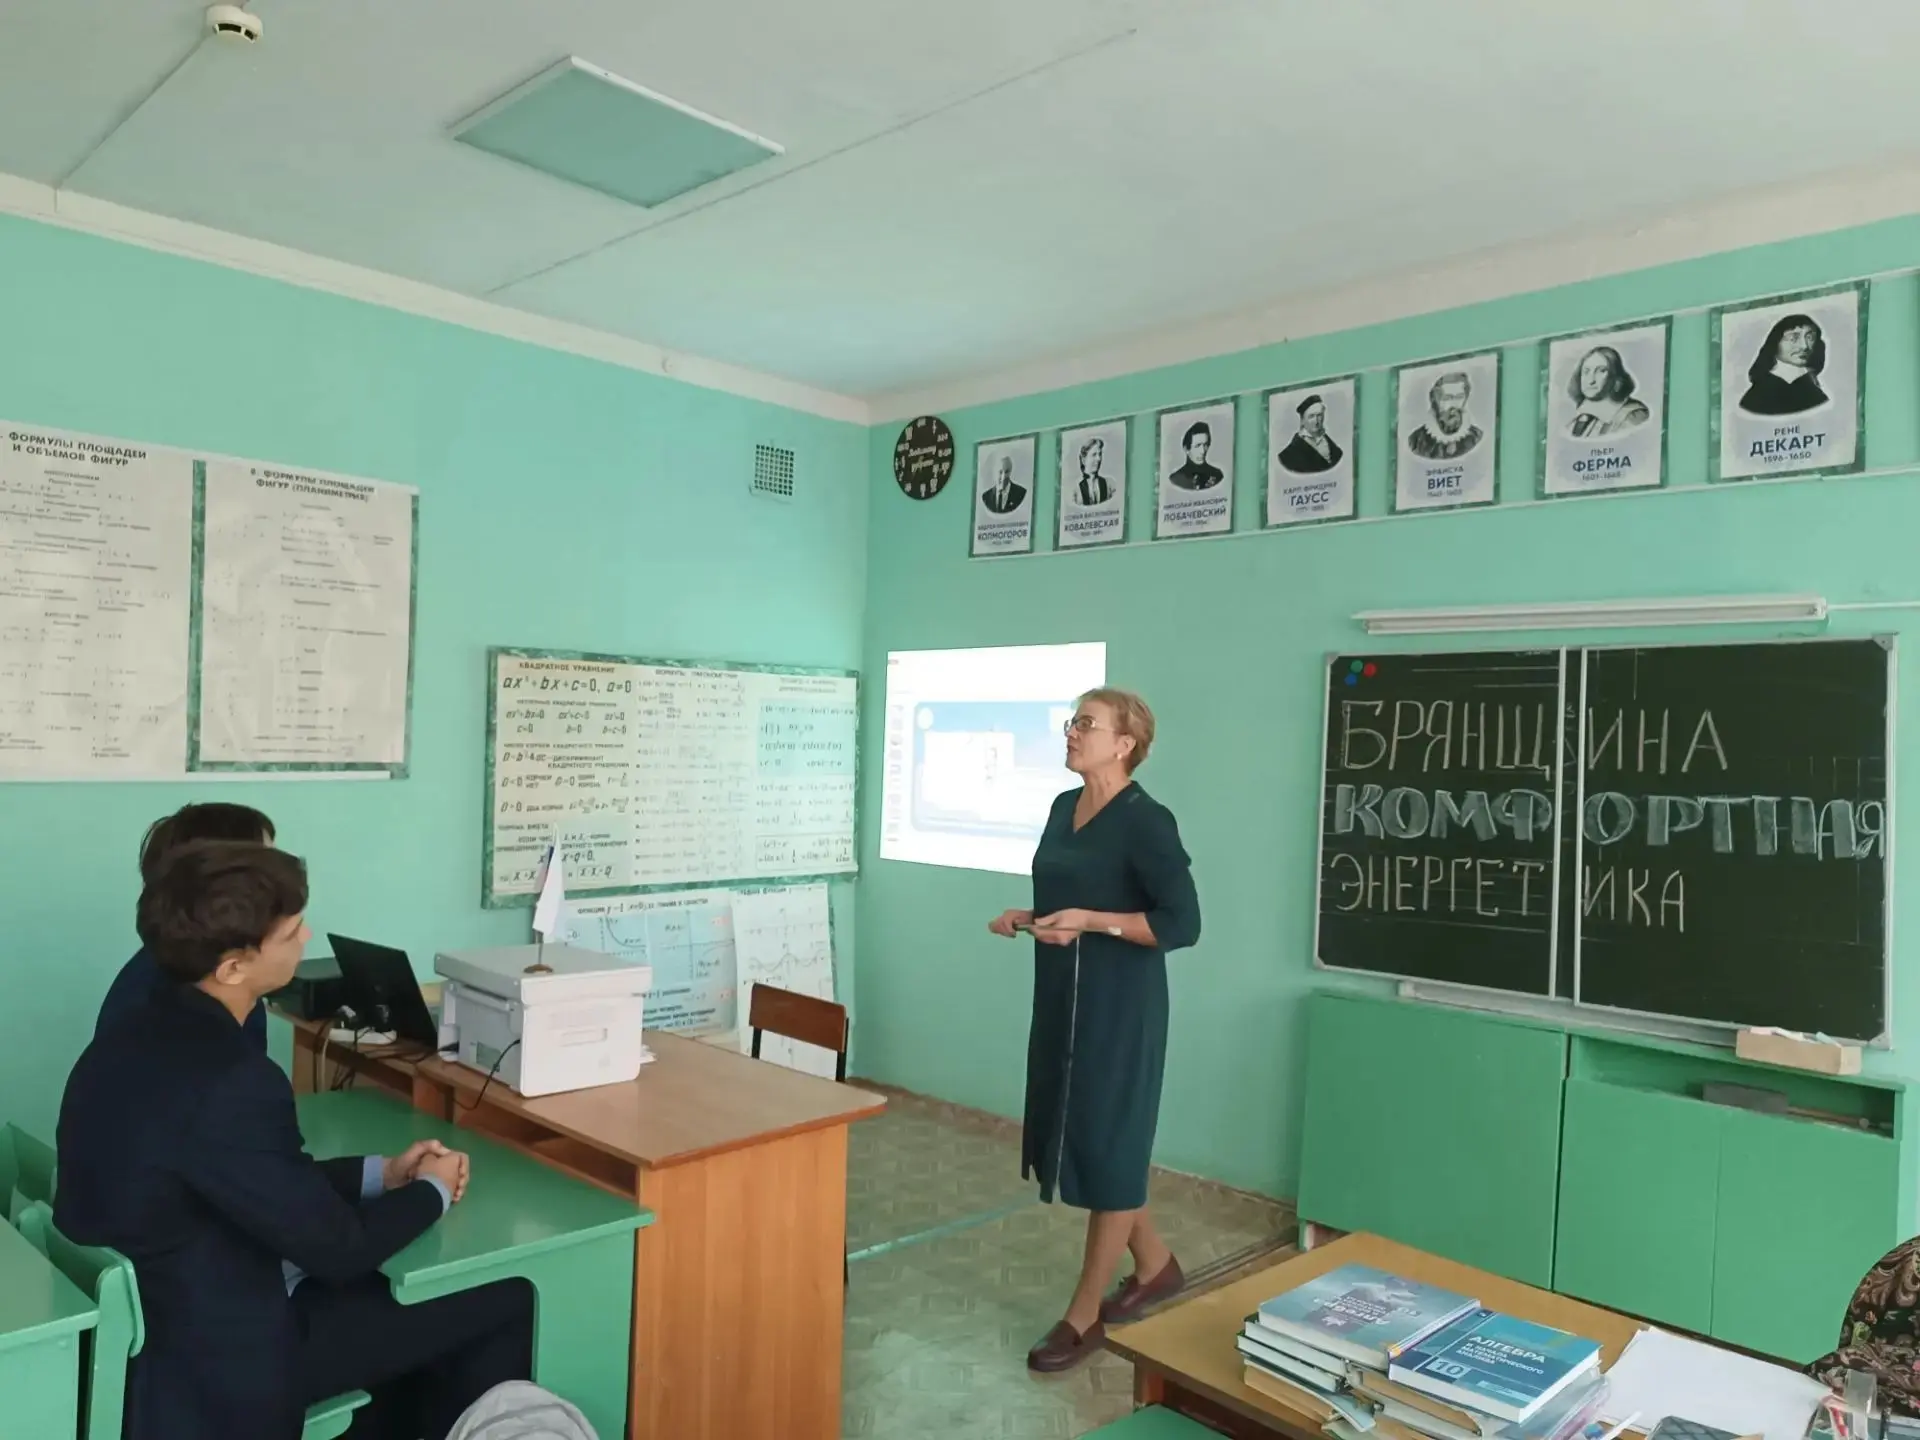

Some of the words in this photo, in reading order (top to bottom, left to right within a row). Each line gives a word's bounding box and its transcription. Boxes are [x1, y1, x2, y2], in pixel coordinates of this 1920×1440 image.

[1774, 424, 1801, 436] РЕНЕ
[9, 431, 73, 448] ФОРМУЛЫ
[1750, 433, 1826, 457] ДЕКАРТ
[13, 443, 21, 452] И
[26, 445, 86, 461] ОБЪЕМОВ
[90, 454, 129, 467] ФИГУР
[1573, 456, 1631, 472] ФЕРМА
[256, 478, 289, 489] ФИГУР
[1427, 475, 1462, 489] ВИЕТ
[1290, 491, 1329, 506] ГАУСС
[1163, 505, 1227, 522] ЛОБАЧЕВСКИЙ
[1064, 518, 1119, 532] КОВАЛЕВСКАЯ
[977, 529, 1028, 541] КОЛМОГОРОВ
[519, 662, 570, 671] КВАДРАТНОЕ
[1334, 784, 1884, 861] КОМФОРТНАЯ
[1331, 853, 1686, 932] ЭНЕРГЕТИКА
[1468, 1335, 1546, 1364] АЛГЕБРА
[1434, 1360, 1465, 1377] 10
[1461, 1345, 1545, 1375] МАТЕМАТИЧЕСКОГО
